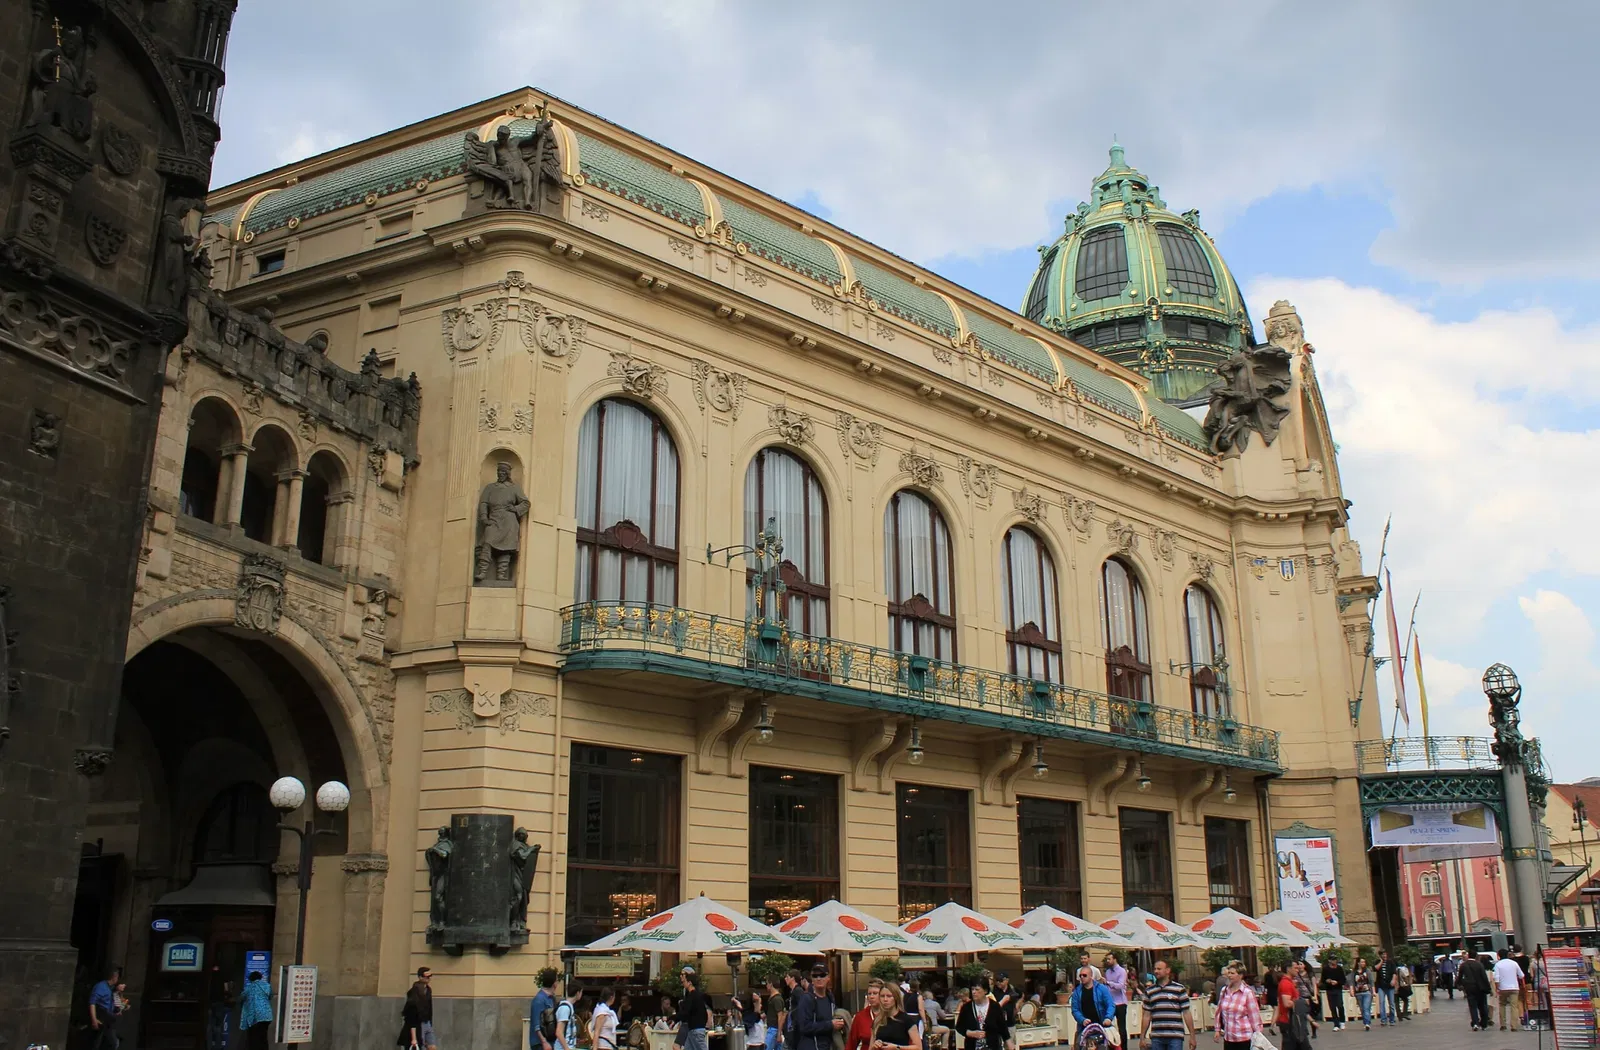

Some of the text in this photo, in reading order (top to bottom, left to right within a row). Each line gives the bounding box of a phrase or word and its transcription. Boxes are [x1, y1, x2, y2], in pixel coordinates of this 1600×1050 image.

[1283, 890, 1311, 899] PROMS
[650, 929, 685, 942] Urquell
[171, 948, 194, 960] CHANGE
